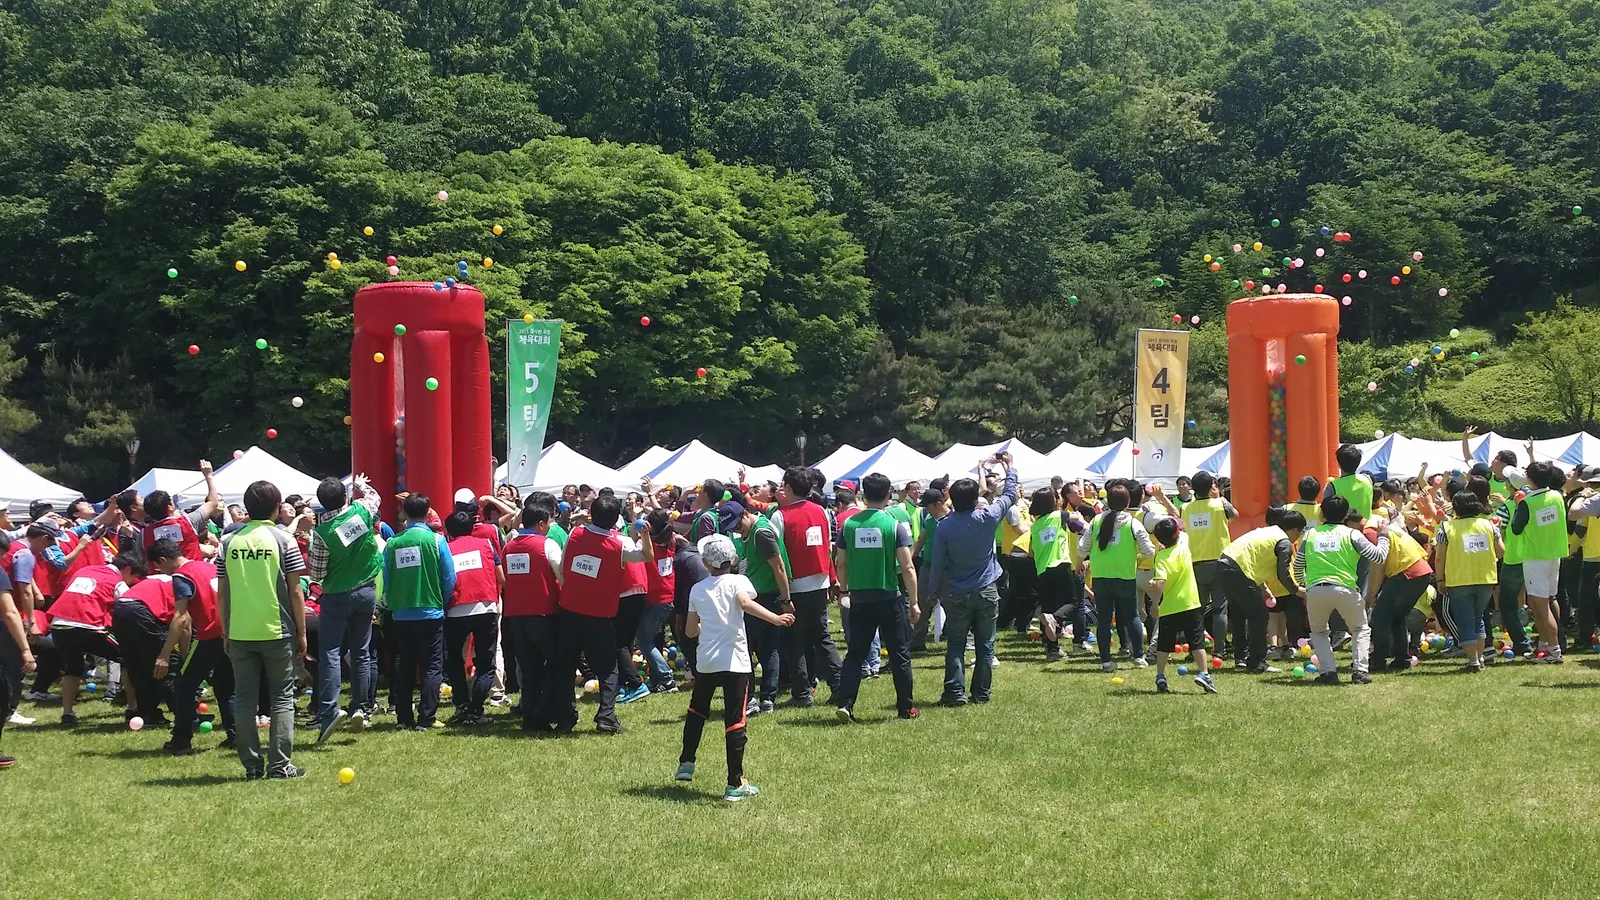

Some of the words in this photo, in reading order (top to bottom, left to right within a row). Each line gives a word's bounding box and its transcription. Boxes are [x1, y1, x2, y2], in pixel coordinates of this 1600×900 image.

[519, 335, 550, 345] 체육대회
[1147, 343, 1178, 352] 체육대회
[525, 363, 539, 393] 5
[1152, 368, 1170, 394] 4
[1151, 404, 1169, 428] 팀
[231, 548, 273, 560] STAFF
